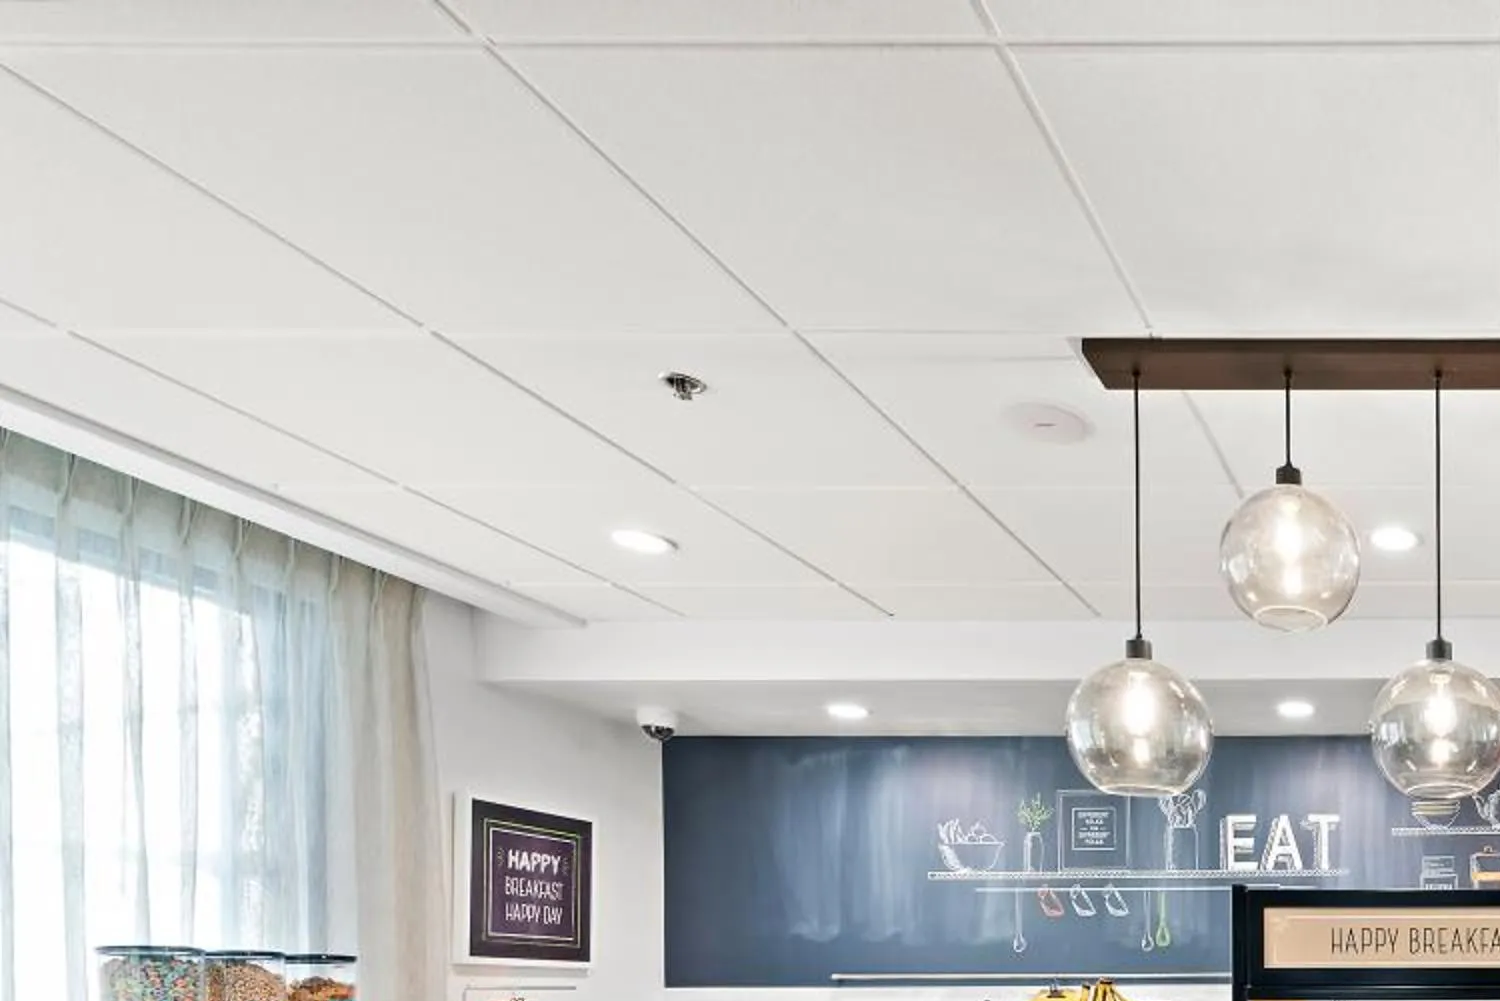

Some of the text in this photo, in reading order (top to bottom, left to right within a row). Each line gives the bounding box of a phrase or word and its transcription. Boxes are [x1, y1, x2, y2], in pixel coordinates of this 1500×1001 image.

[1220, 813, 1340, 871] EAT
[507, 848, 561, 875] HAPPY
[504, 875, 565, 901] BREAKFAST
[505, 902, 564, 925] HAPPY DAY
[1330, 926, 1400, 955] HAPPY
